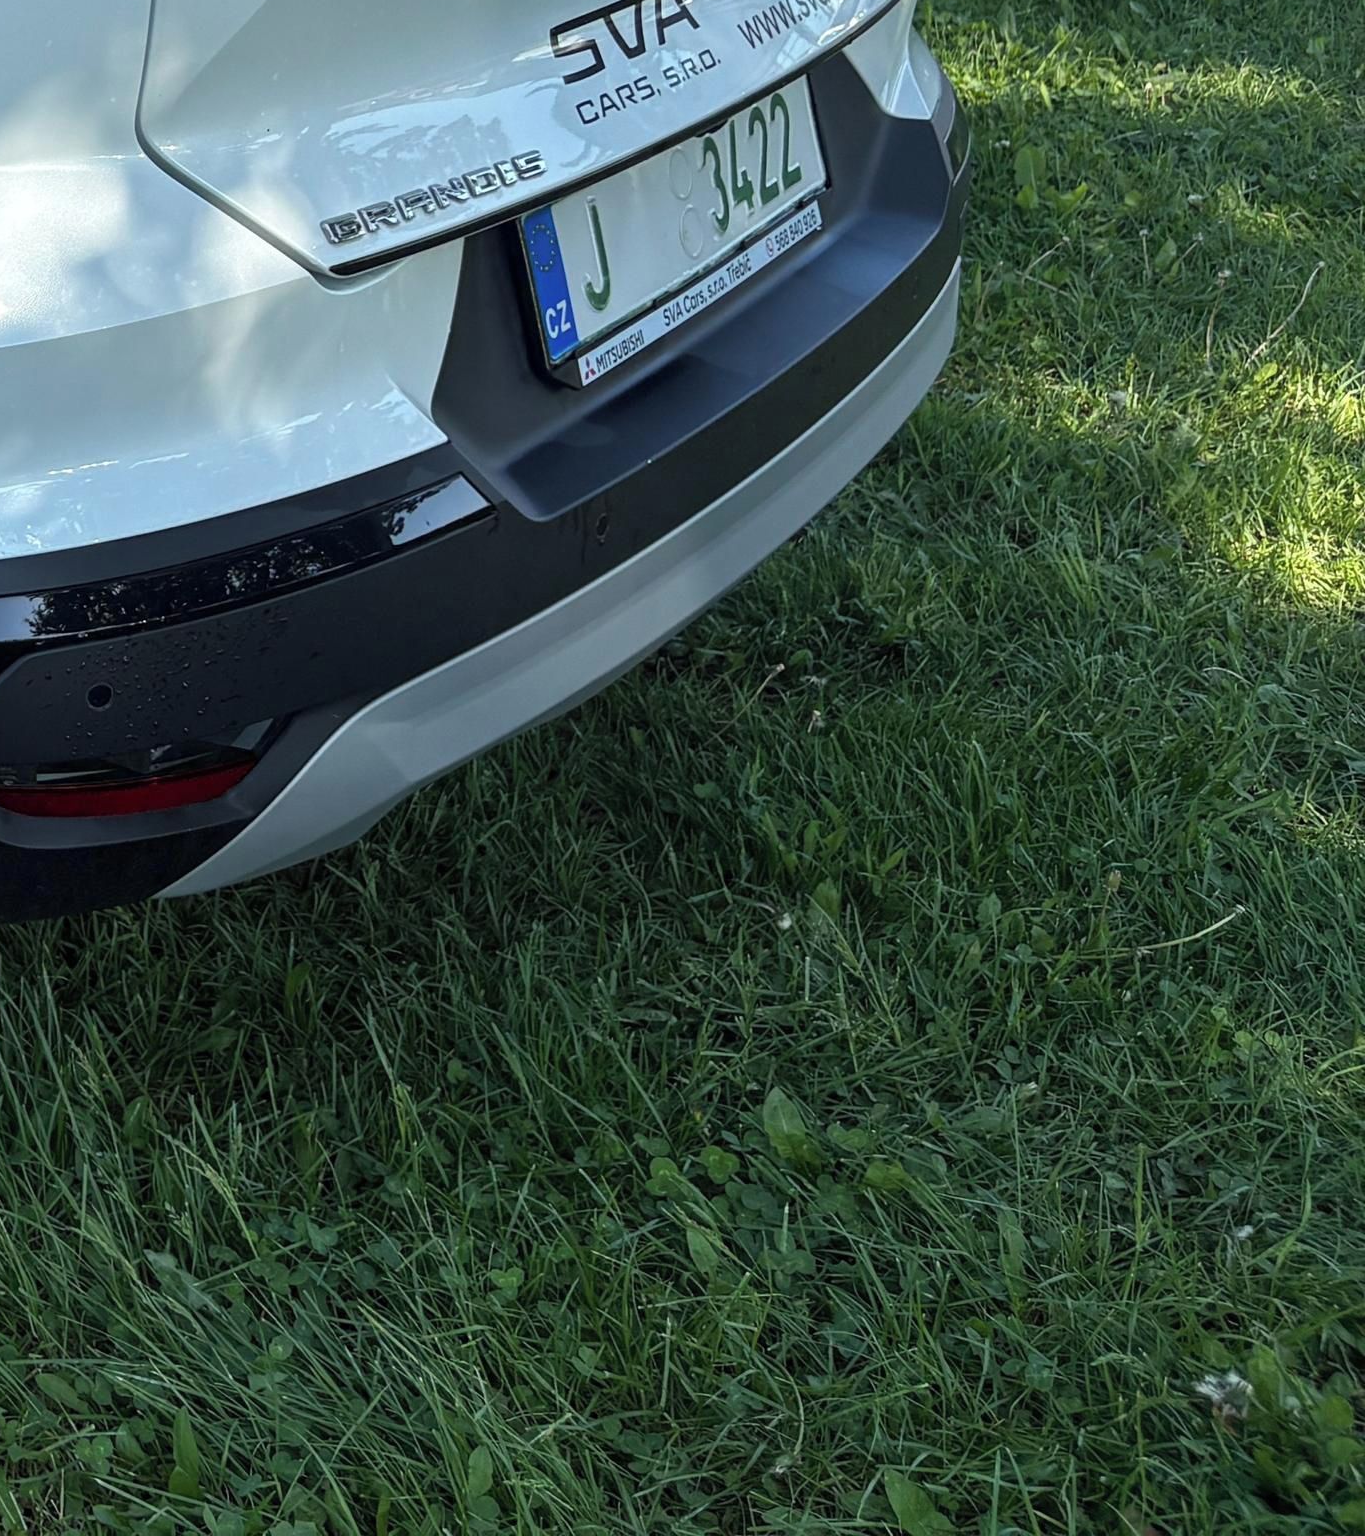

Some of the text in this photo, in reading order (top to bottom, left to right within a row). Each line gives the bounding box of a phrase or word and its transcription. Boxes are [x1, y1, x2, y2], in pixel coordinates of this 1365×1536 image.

[575, 49, 722, 125] CARS, S.R.O.
[320, 149, 549, 245] GRANDIS
[698, 92, 803, 235] 3422
[545, 299, 572, 340] CZ
[595, 330, 645, 374] MITSUBISHI
[662, 301, 684, 327] SVA
[683, 289, 707, 314] Cars,
[707, 276, 728, 299] s.r.o.
[774, 228, 790, 252] 568
[803, 209, 818, 230] 926
